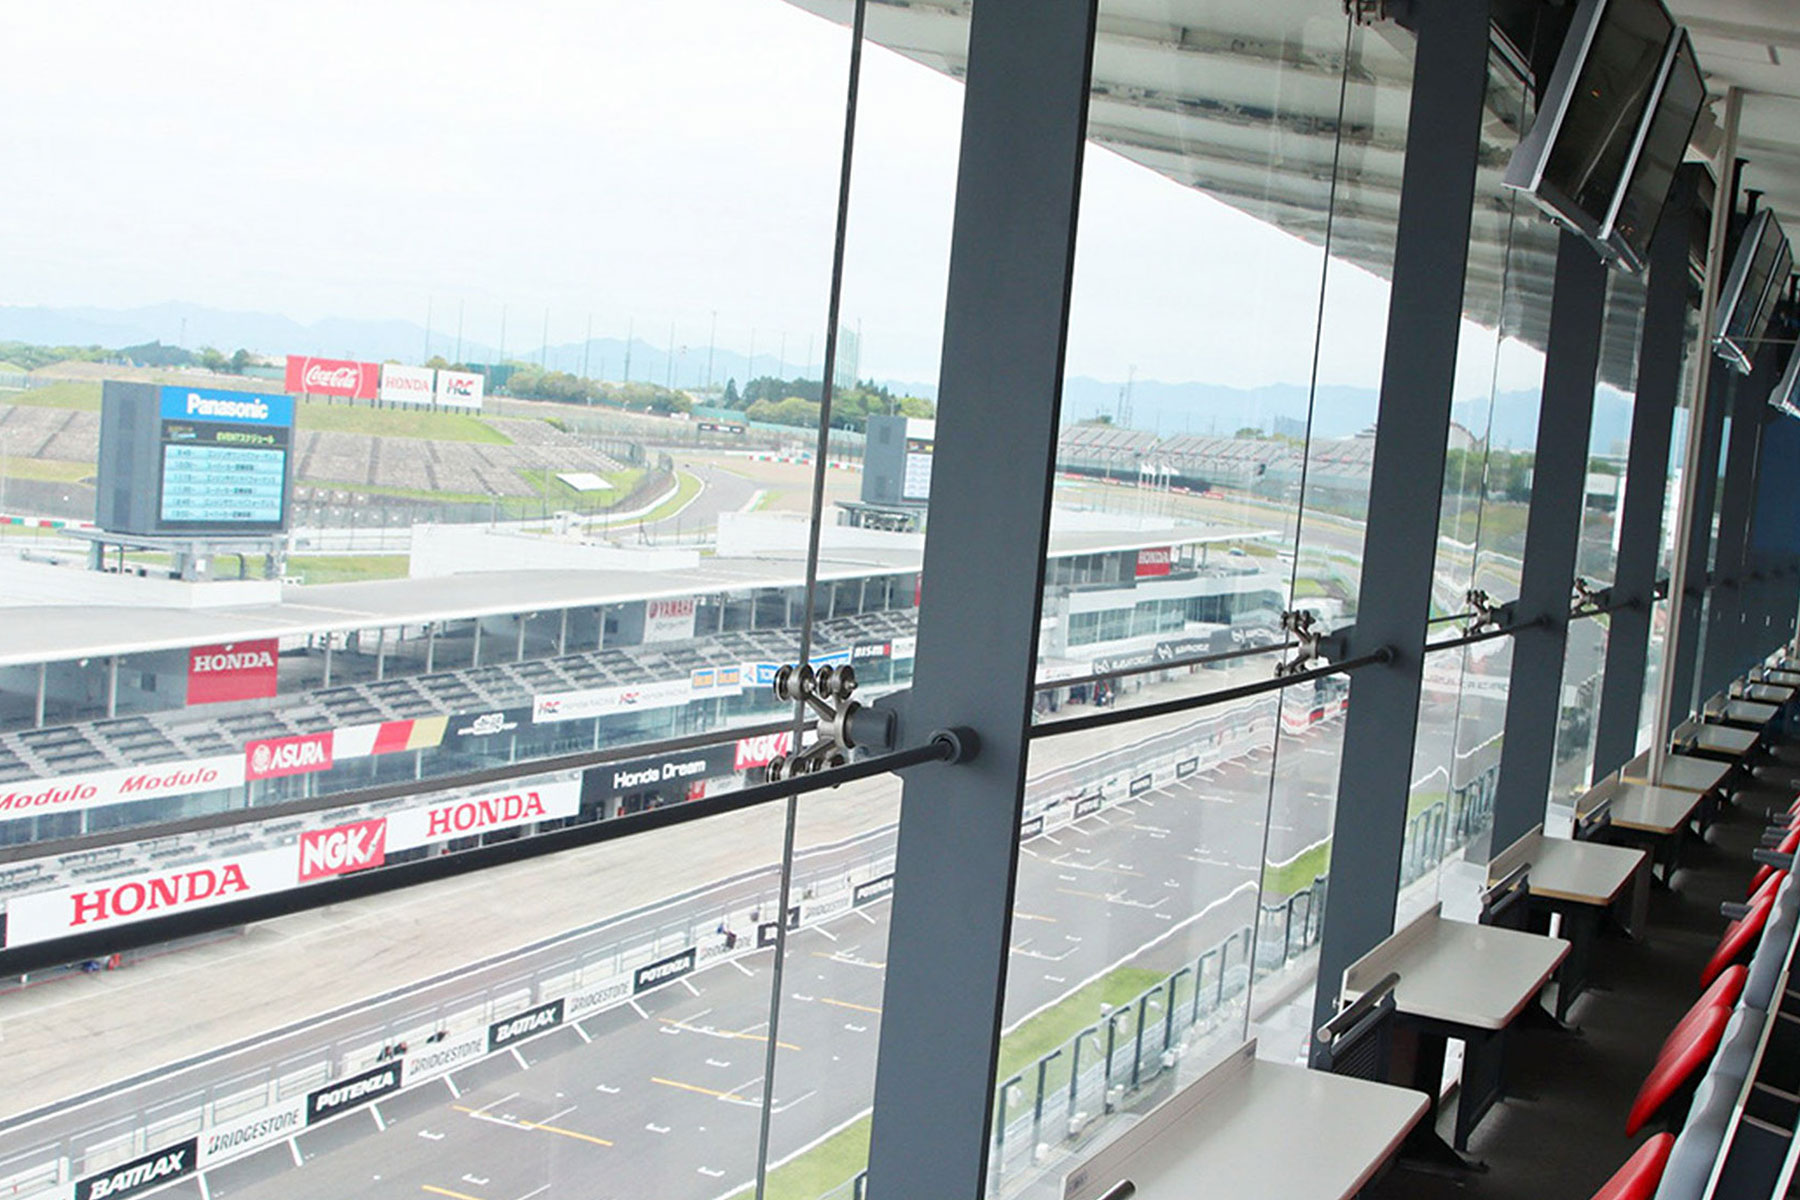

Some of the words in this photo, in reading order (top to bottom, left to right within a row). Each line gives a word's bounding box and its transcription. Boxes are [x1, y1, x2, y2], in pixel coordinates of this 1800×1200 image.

[306, 364, 358, 389] Coca-Cola
[385, 376, 429, 392] HONDA
[186, 392, 269, 419] Panasonic
[193, 651, 274, 672] HONDA
[270, 740, 326, 770] ASURA
[118, 767, 218, 795] Modulo
[613, 768, 660, 790] Honda
[662, 760, 706, 781] Dream
[426, 791, 546, 838] HONDA
[303, 826, 368, 876] NGK
[69, 863, 250, 927] HONDA
[639, 957, 691, 985] POTENZA
[409, 1038, 483, 1076] BRIDGESTONE
[315, 1071, 395, 1112] POTENZA
[207, 1108, 300, 1156] BRIDGESTONE
[89, 1150, 187, 1200] BATTLAX
